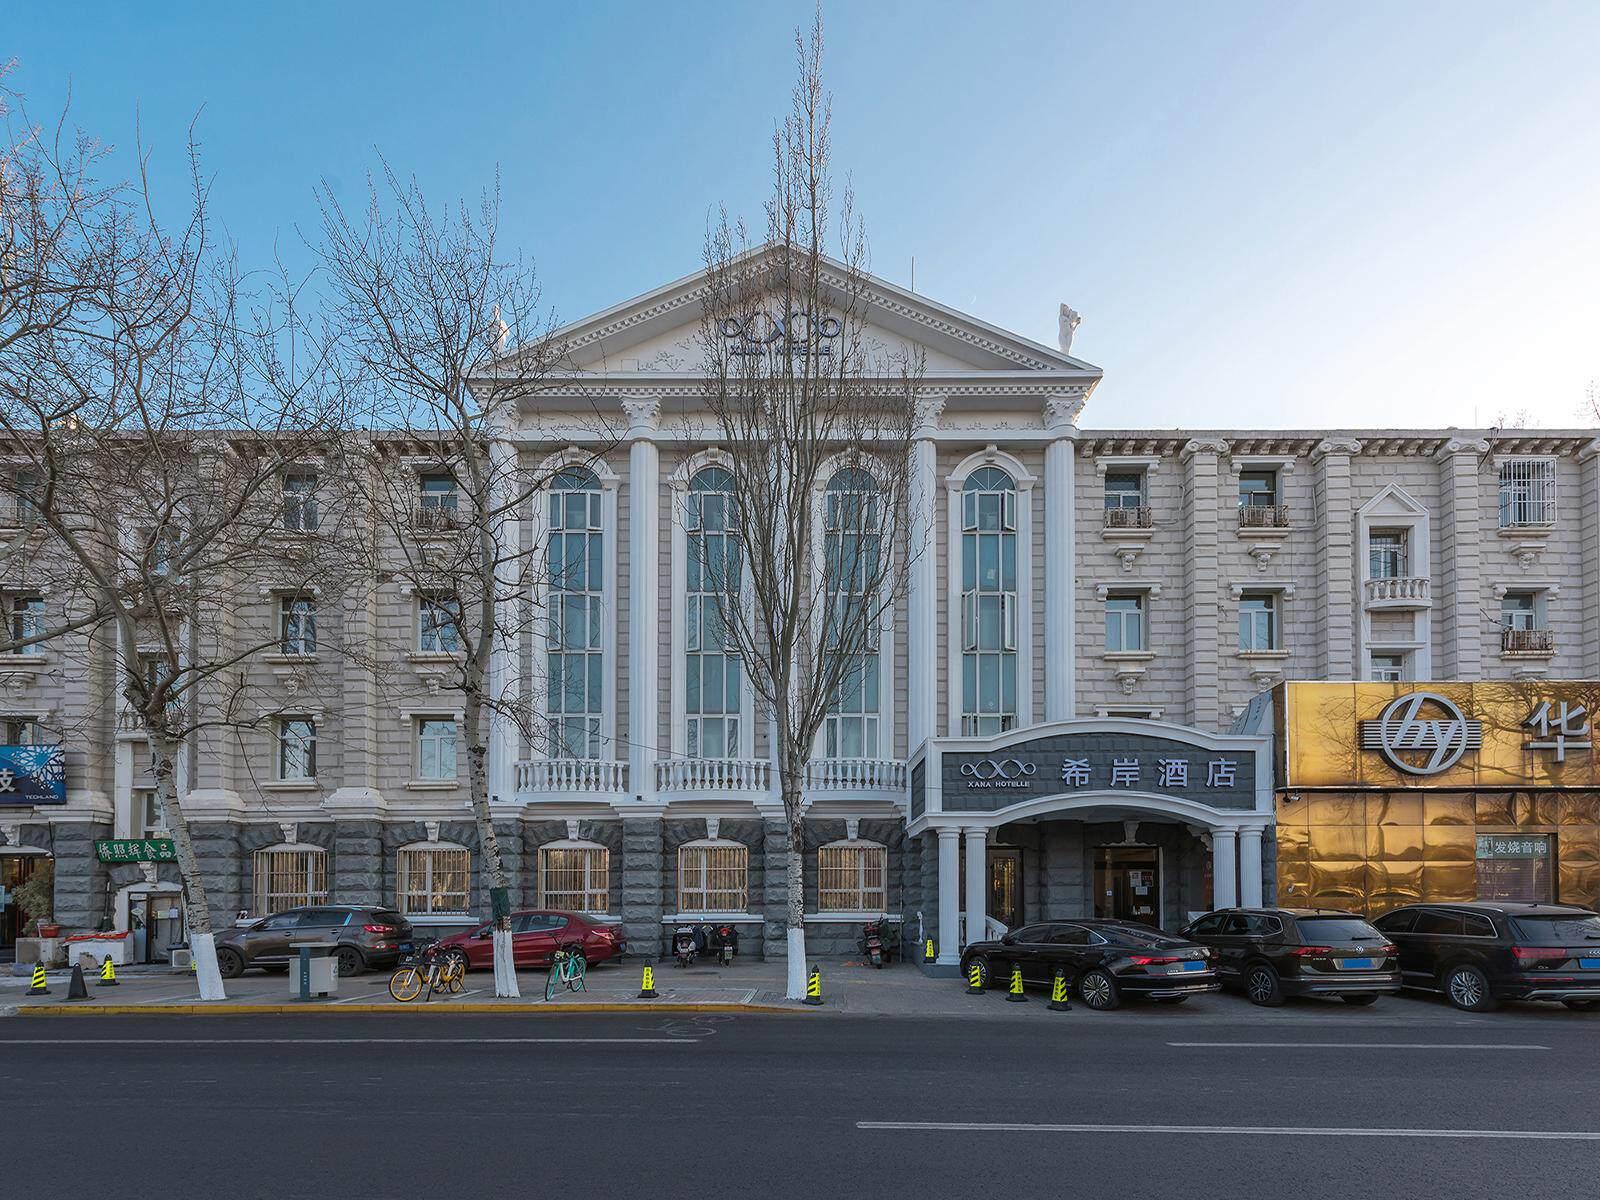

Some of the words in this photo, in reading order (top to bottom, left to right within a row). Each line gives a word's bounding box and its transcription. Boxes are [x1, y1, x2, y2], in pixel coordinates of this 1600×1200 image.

[1528, 701, 1592, 763] 华
[1061, 757, 1238, 788] 希岸酒店
[967, 780, 992, 788] XANA
[995, 780, 1031, 788] HOTELLE
[1494, 840, 1547, 854] 发烧音响
